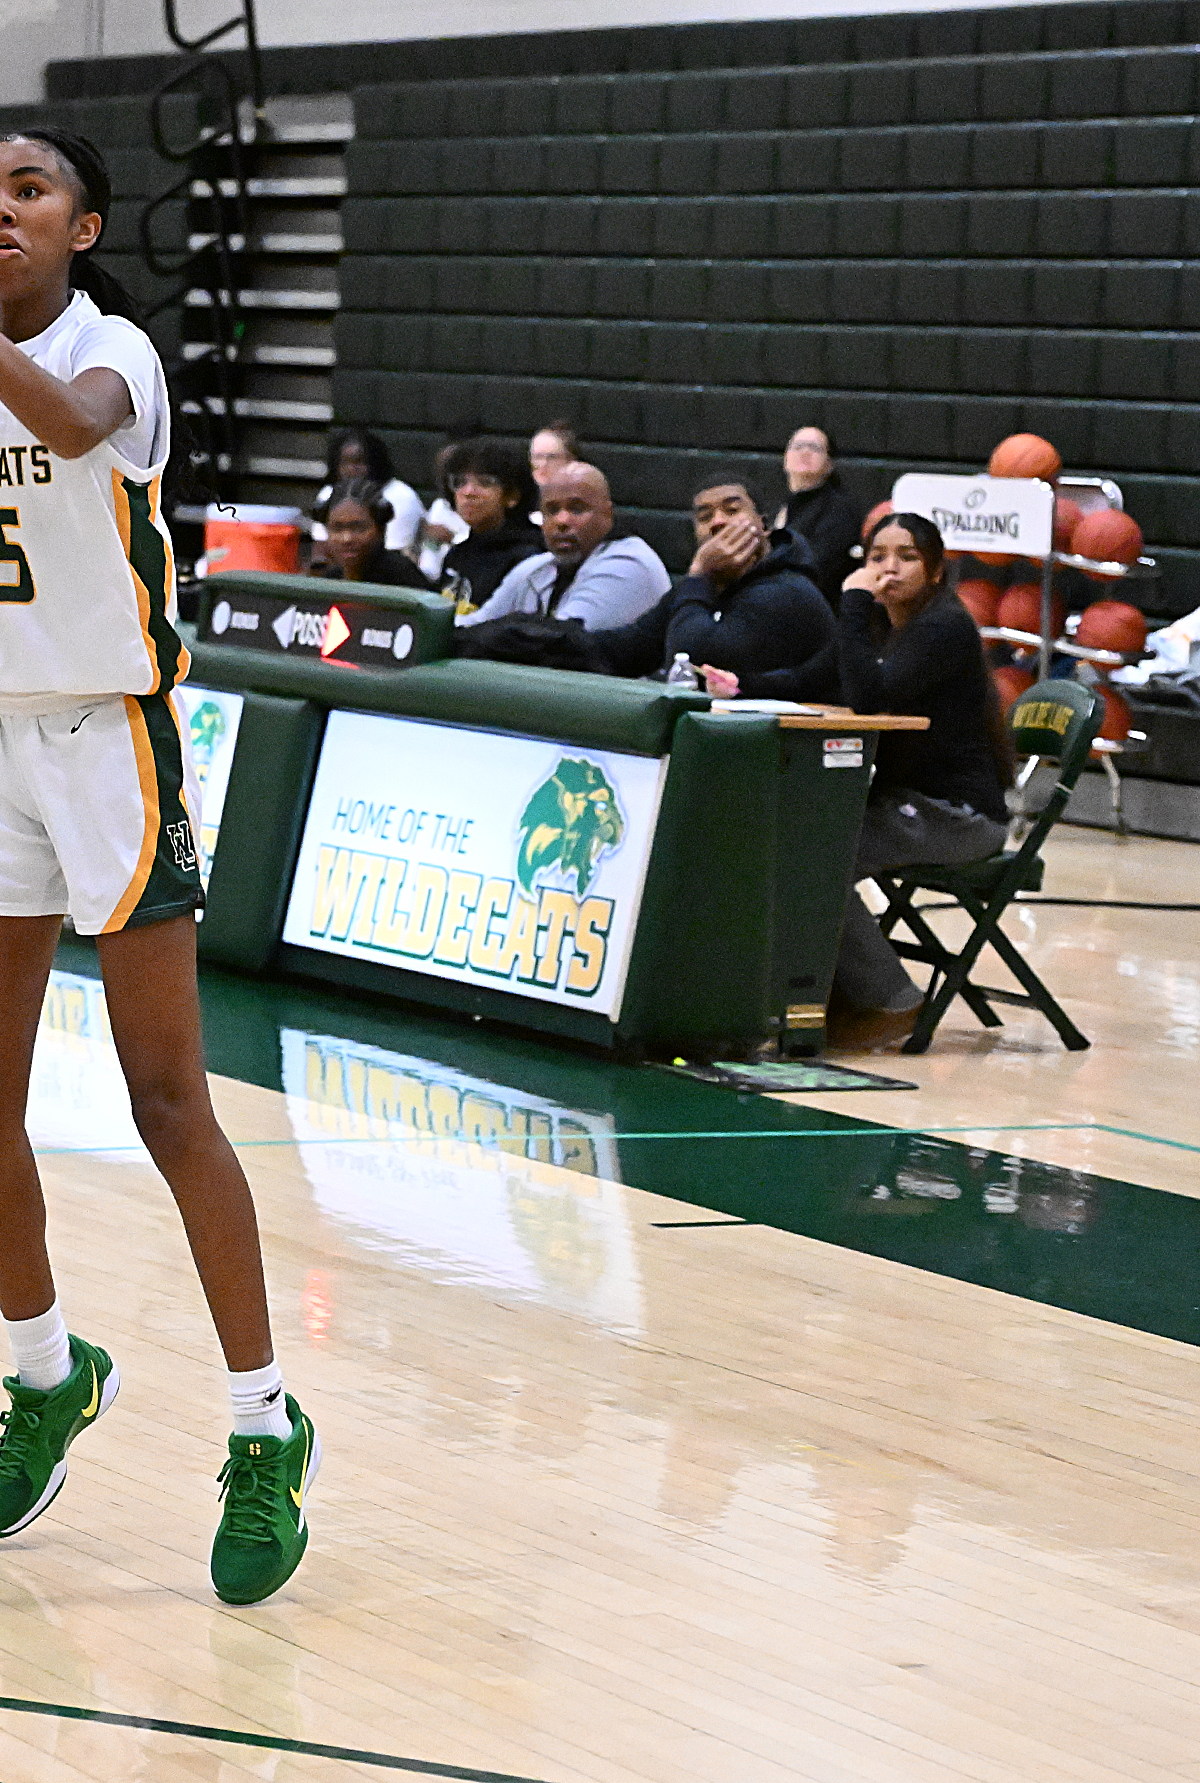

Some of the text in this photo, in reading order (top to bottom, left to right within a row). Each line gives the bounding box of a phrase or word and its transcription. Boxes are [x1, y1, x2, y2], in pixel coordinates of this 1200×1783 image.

[932, 506, 1019, 539] SPALDING
[332, 797, 475, 855] HOME OF THE
[311, 845, 616, 998] WILDECATS
